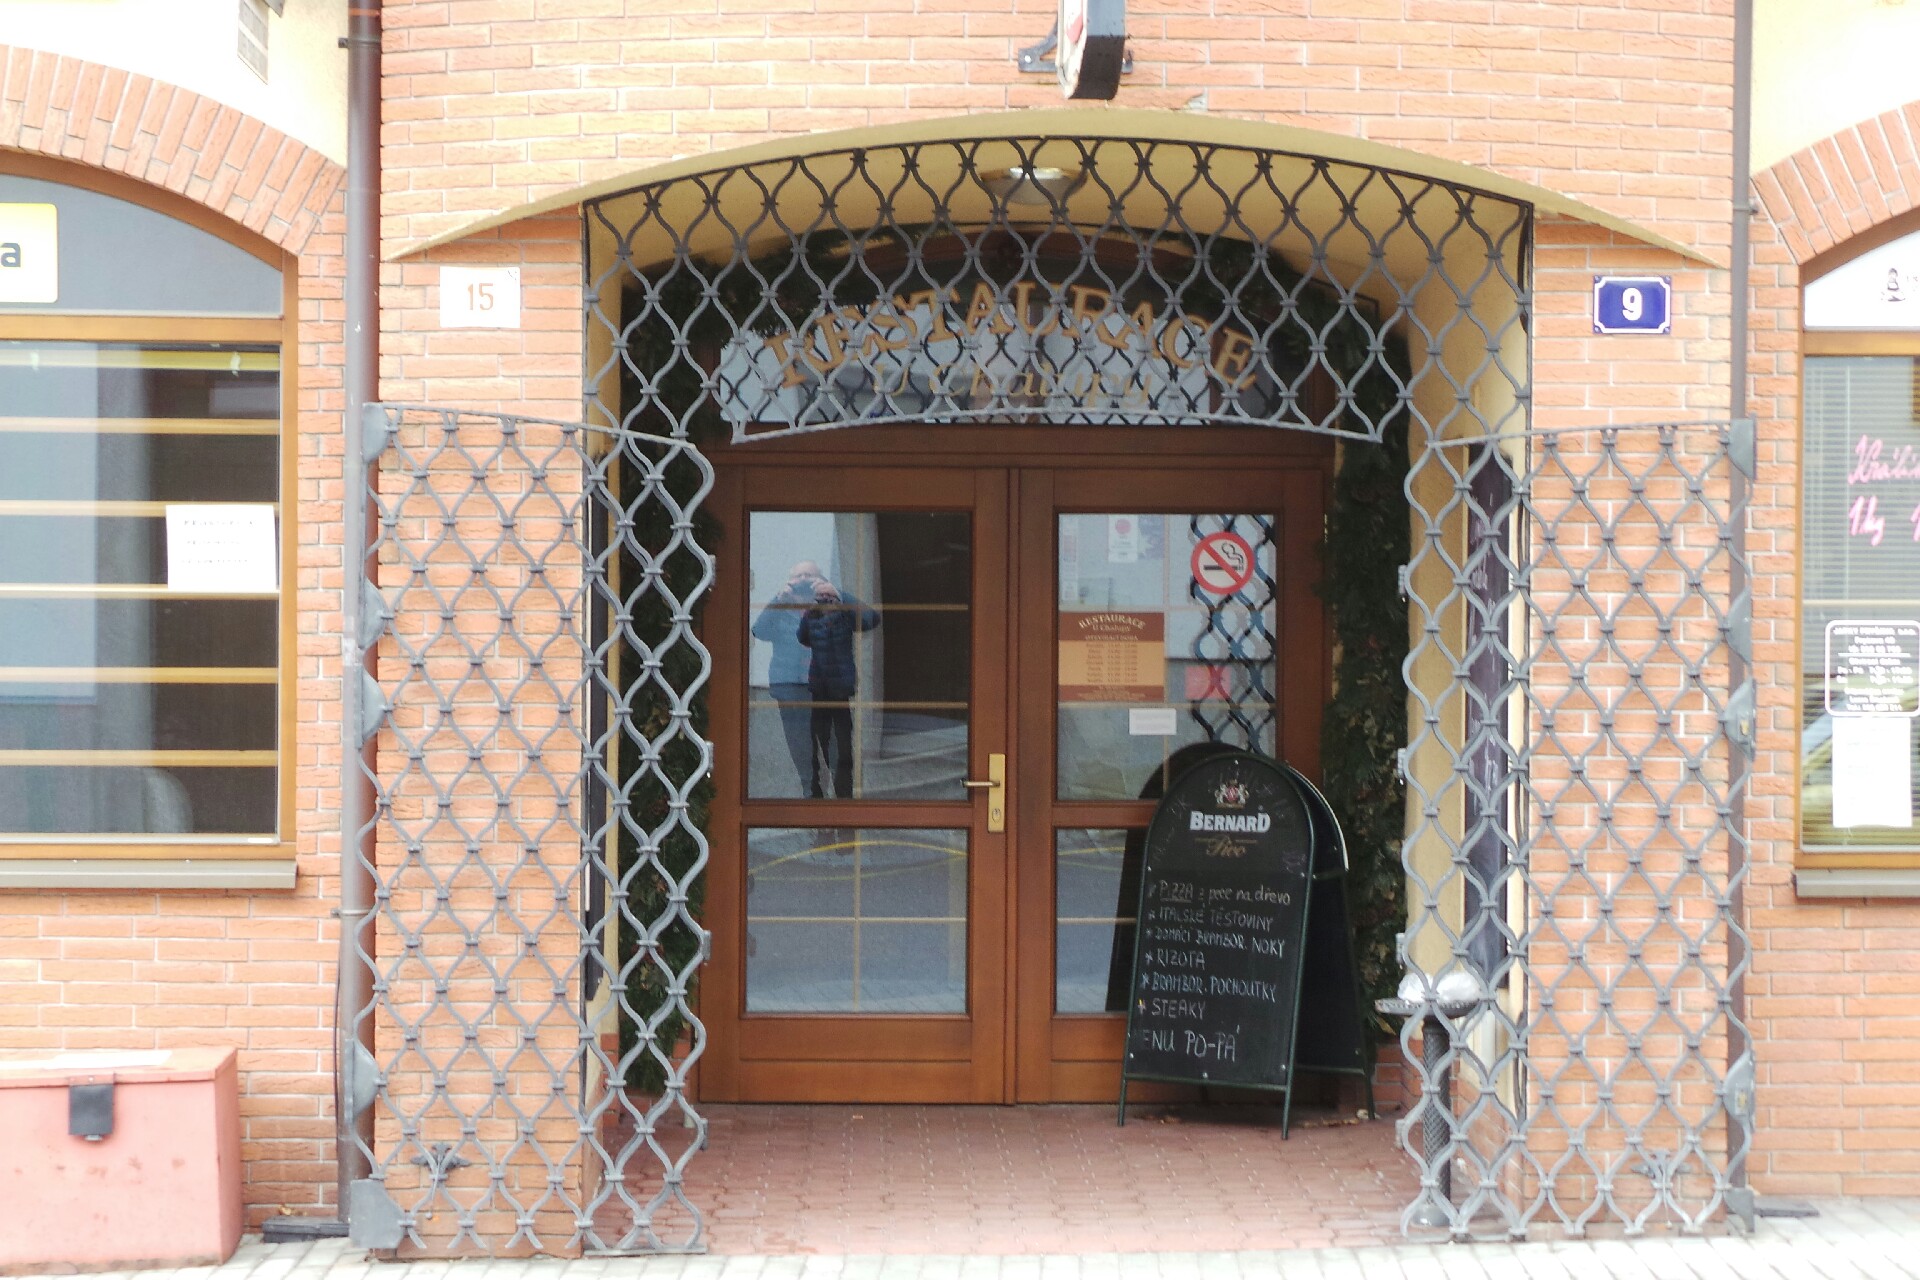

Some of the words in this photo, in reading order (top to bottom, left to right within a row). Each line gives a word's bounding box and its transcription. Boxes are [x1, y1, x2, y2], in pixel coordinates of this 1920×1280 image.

[467, 282, 494, 311] 15
[1622, 287, 1643, 321] 9
[764, 281, 1257, 391] RESTAURACE
[1078, 614, 1146, 630] RESTAURACE
[1190, 810, 1271, 833] BERNARD
[1252, 936, 1286, 959] NOKY
[1210, 975, 1277, 1003] POCHOUTKY
[1151, 997, 1206, 1020] STEAKY
